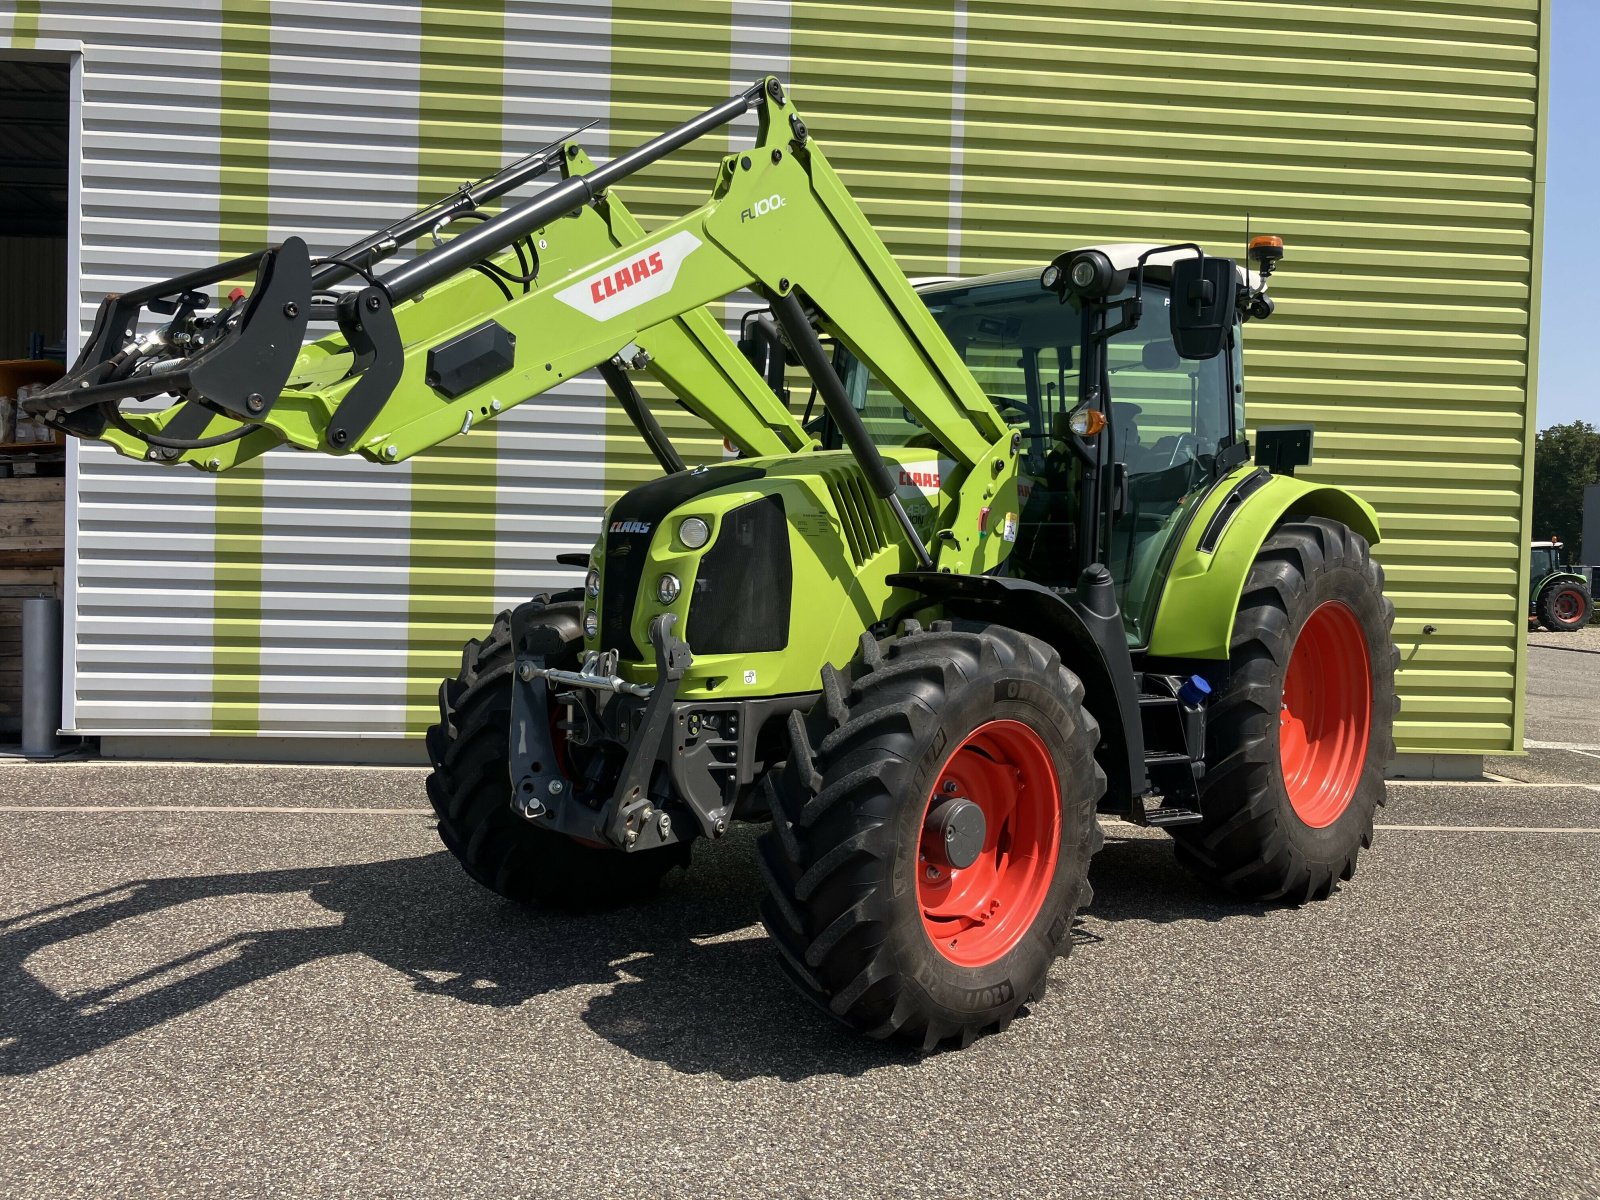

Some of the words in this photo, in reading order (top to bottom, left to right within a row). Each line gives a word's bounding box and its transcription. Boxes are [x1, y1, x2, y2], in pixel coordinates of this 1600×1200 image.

[590, 251, 664, 304] CLAAS
[899, 471, 941, 488] CLAAS
[907, 504, 928, 516] 430
[609, 521, 652, 534] CLAAS
